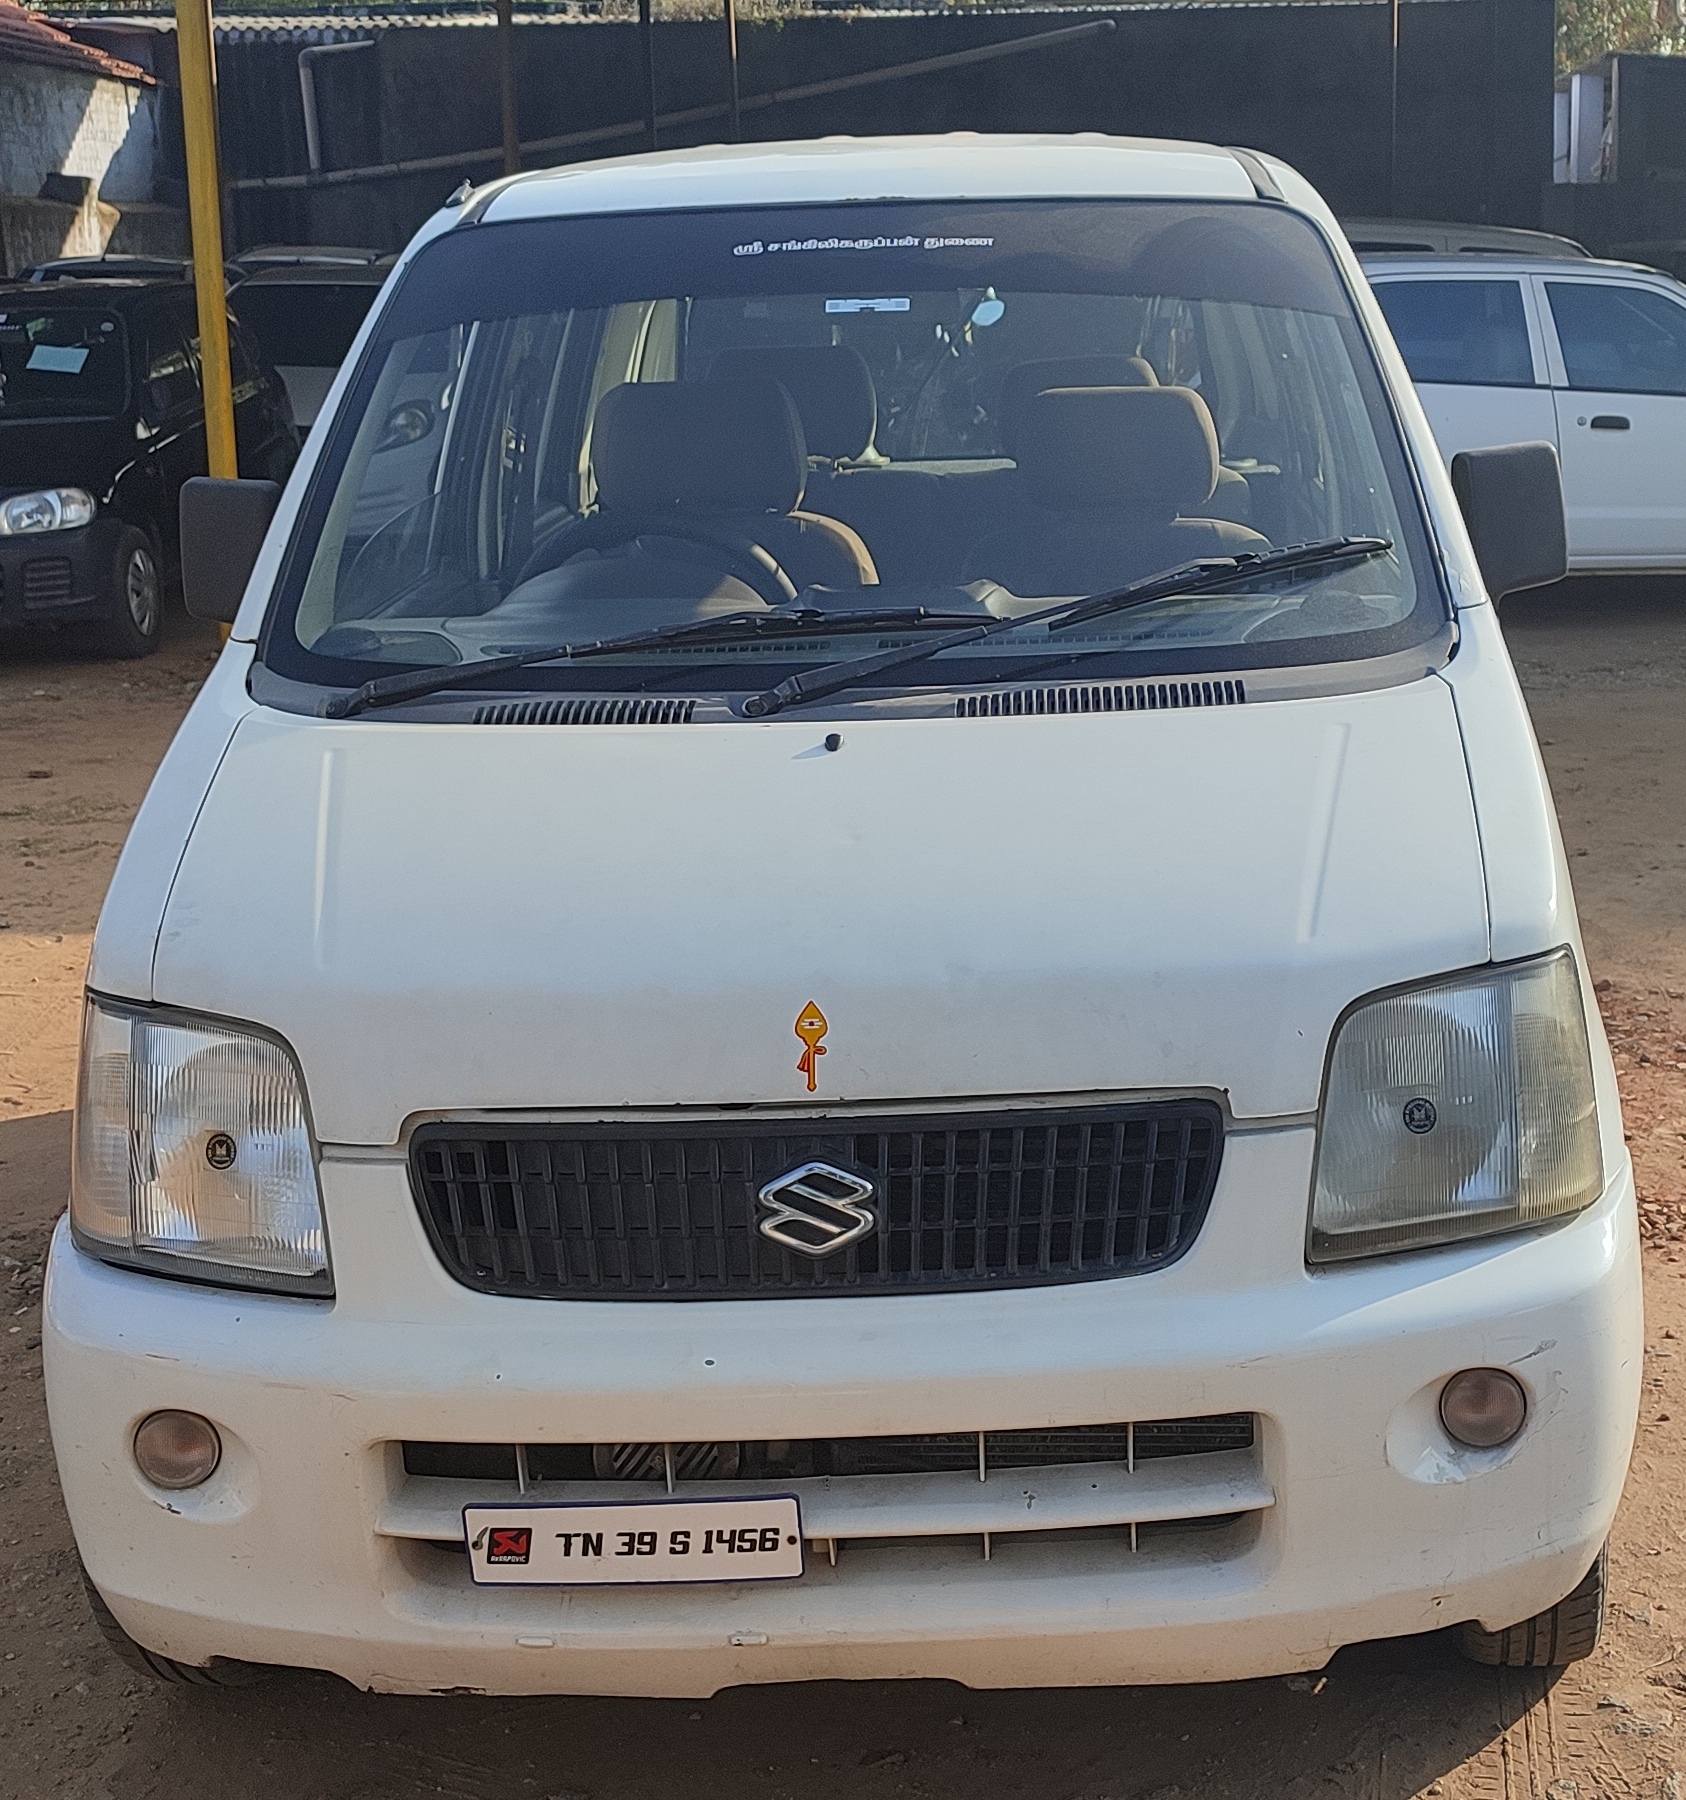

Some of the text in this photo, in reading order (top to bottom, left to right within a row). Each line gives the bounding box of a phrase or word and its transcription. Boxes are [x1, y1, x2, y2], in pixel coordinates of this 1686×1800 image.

[923, 236, 995, 250] துணை
[555, 1527, 780, 1557] TN 39 S 1456
